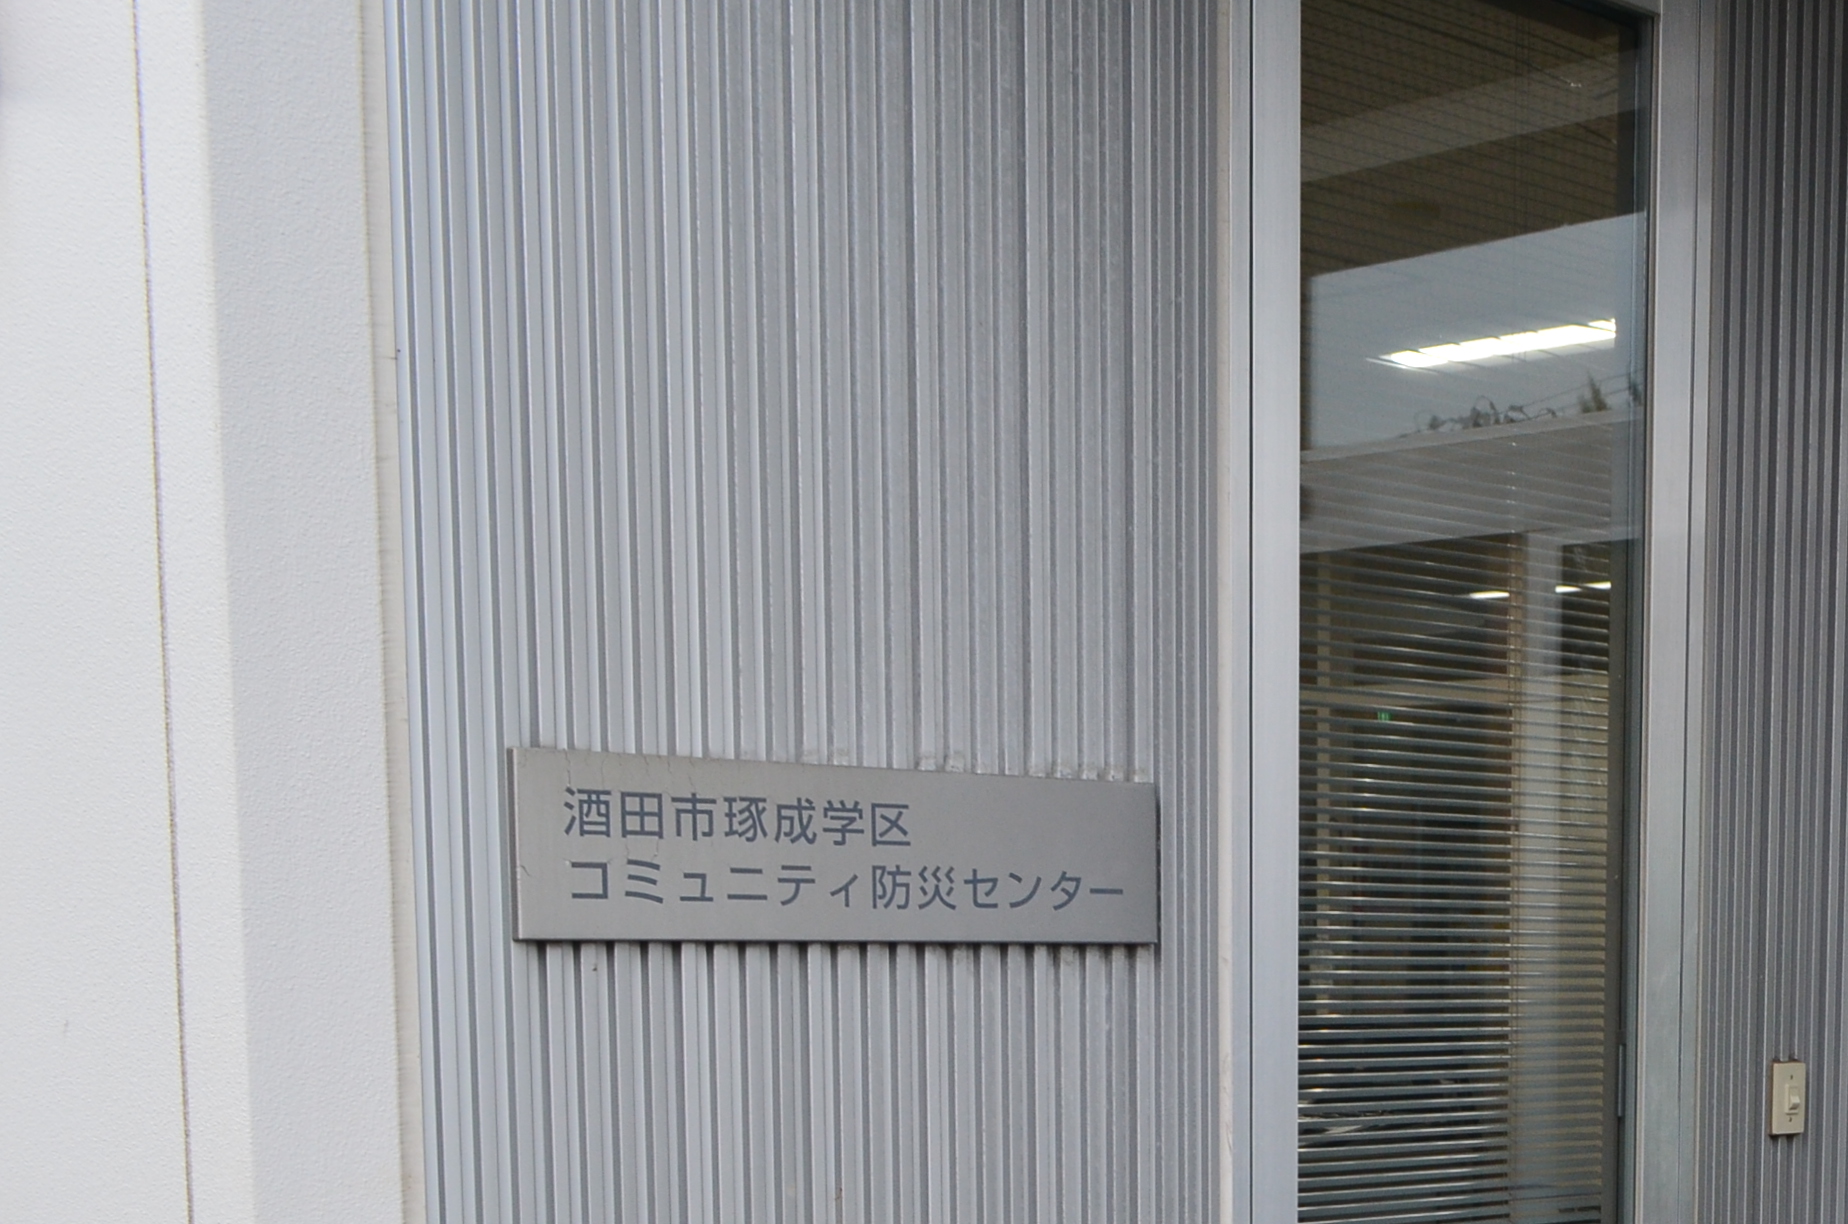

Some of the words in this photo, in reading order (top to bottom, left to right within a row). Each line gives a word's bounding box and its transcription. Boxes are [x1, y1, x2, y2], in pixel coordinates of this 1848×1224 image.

[563, 785, 911, 847] 酒田市琢成学区
[568, 857, 1124, 912] コミュニティ防災センター
